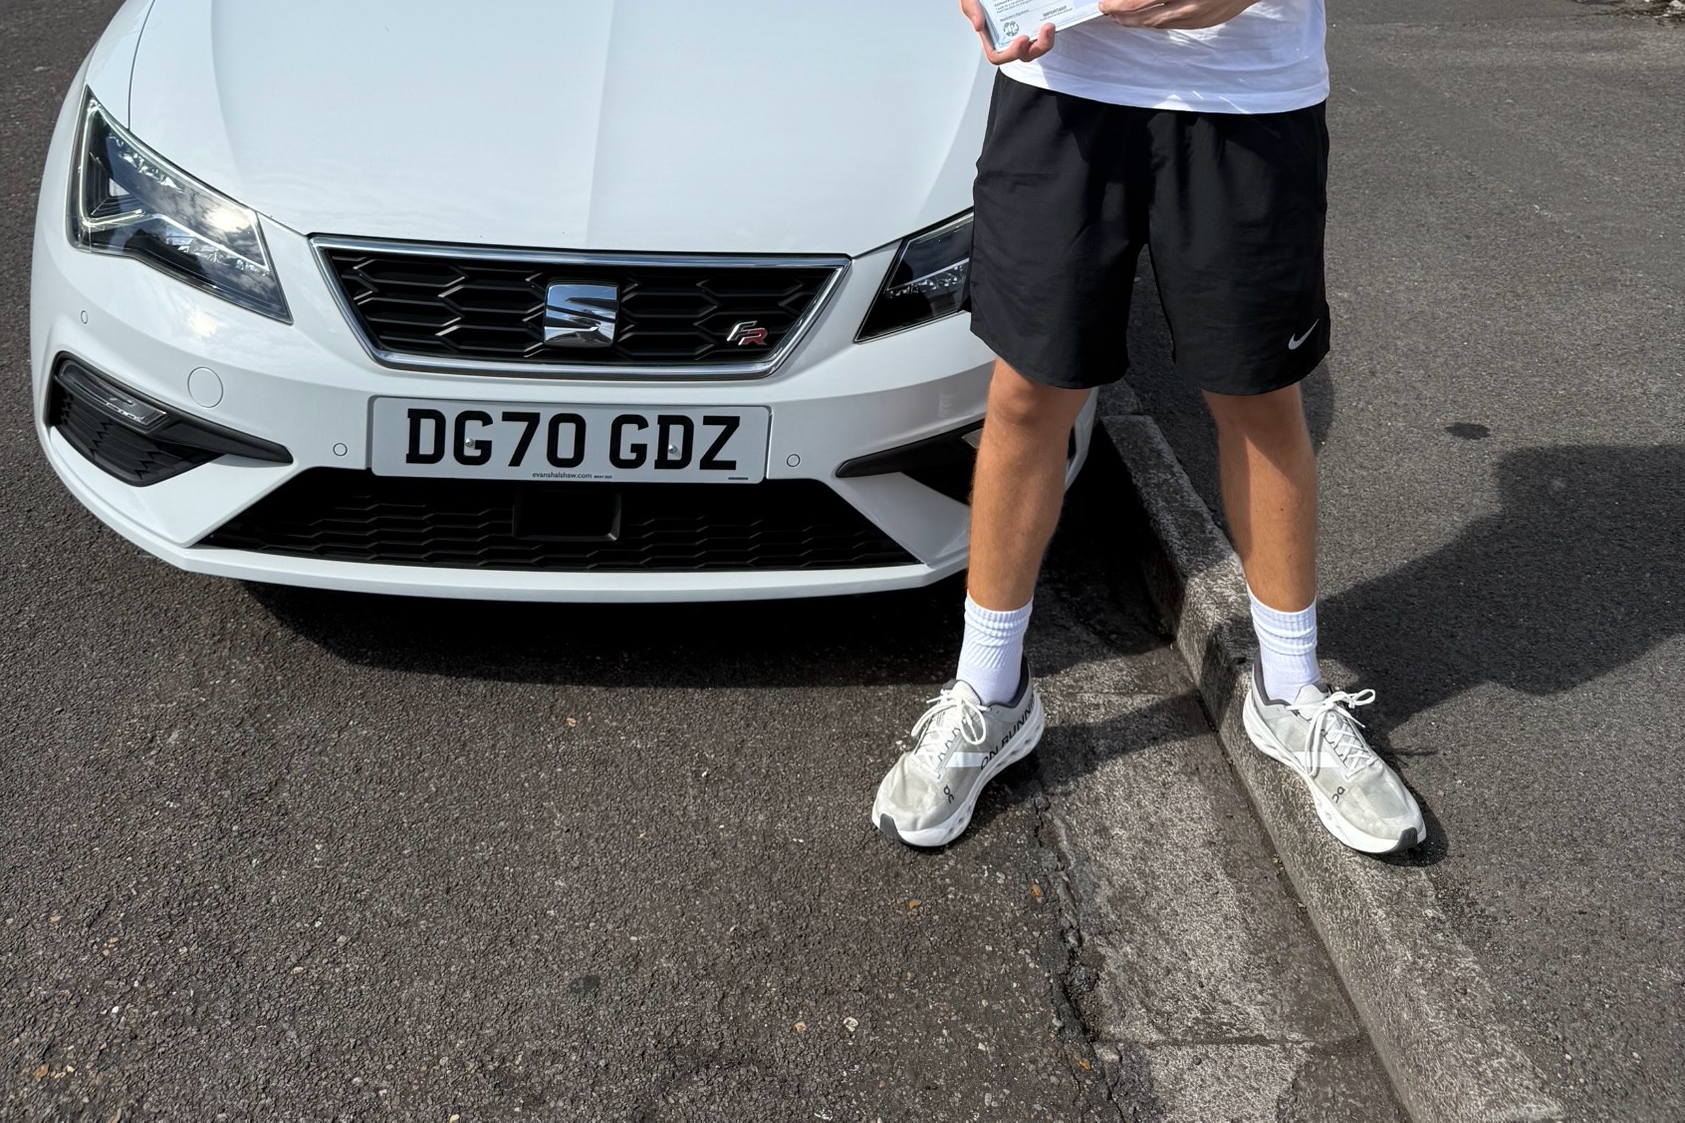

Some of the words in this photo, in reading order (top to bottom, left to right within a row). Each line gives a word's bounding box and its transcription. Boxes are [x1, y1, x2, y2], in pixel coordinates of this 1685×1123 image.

[726, 320, 768, 346] FR
[405, 407, 587, 469] DG70
[608, 413, 741, 471] GDZ
[532, 471, 593, 480] evanshalshaw.com
[980, 746, 999, 770] ON
